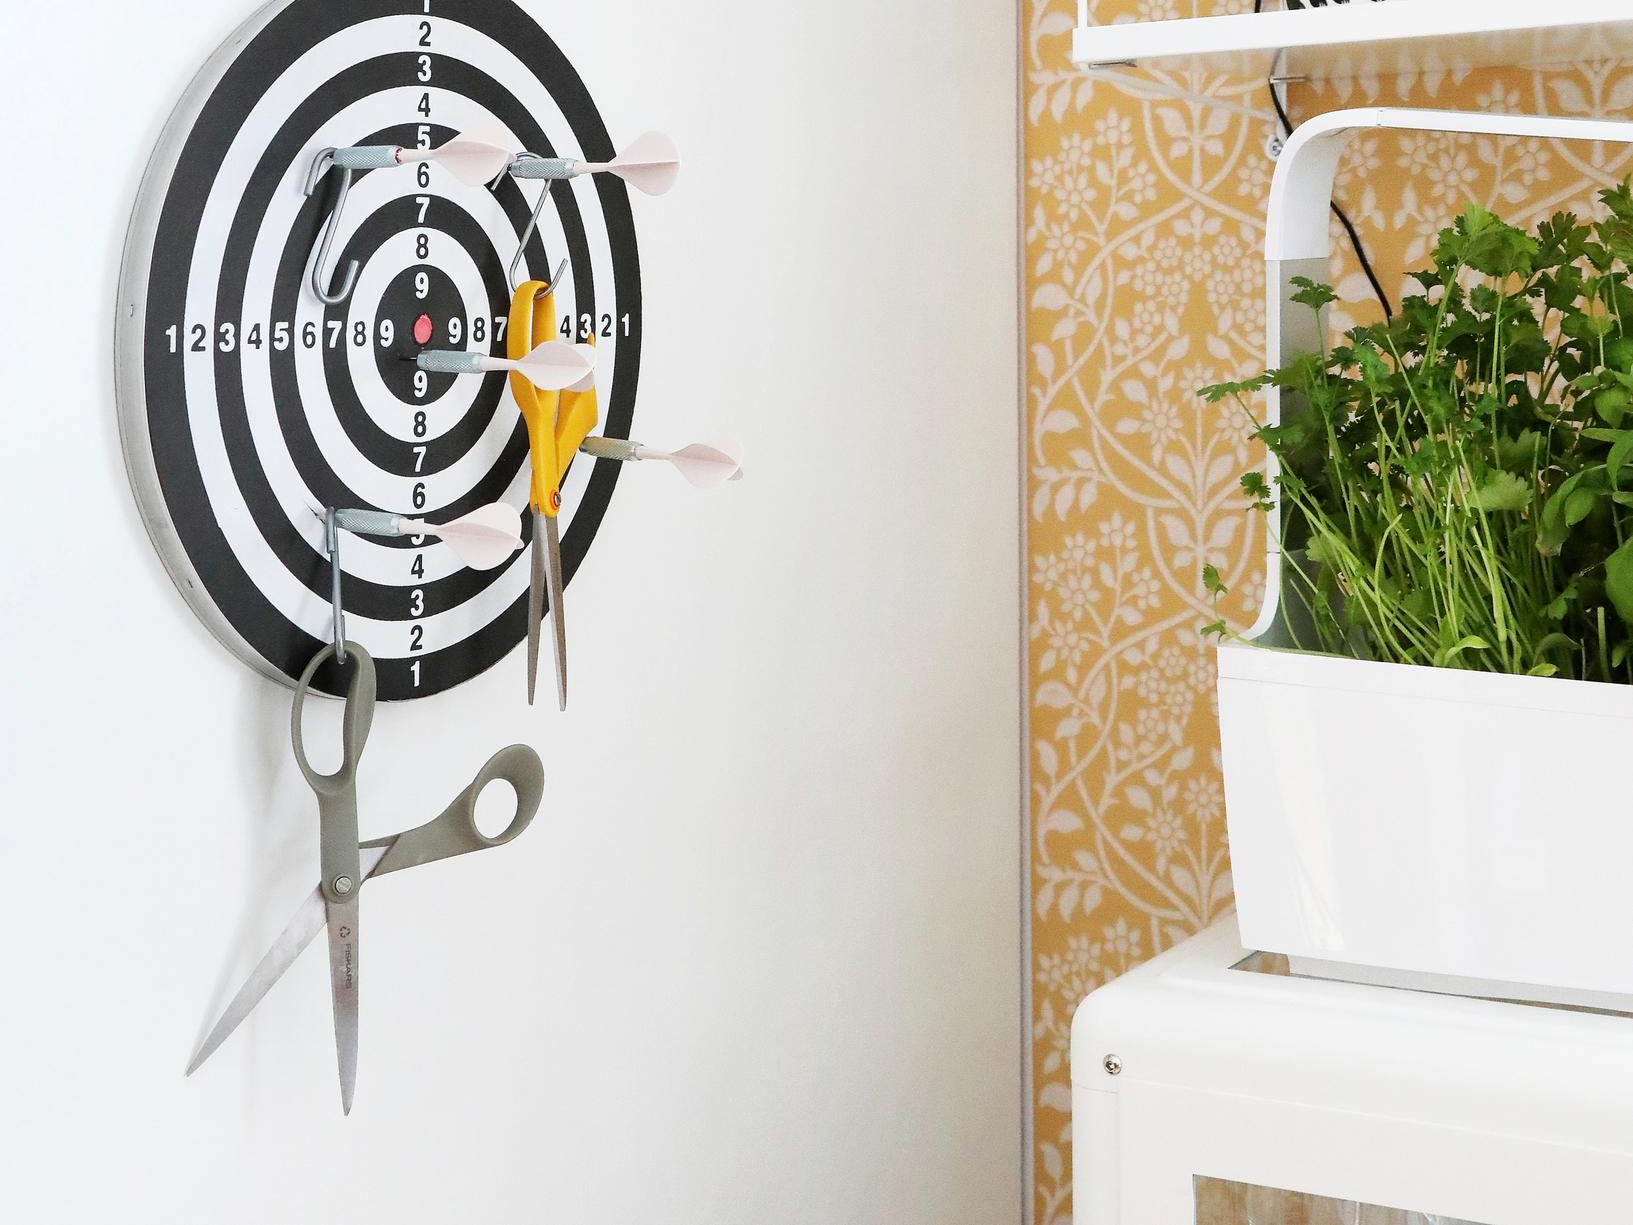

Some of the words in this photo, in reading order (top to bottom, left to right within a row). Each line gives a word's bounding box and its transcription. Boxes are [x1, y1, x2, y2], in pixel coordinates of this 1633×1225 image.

[419, 21, 431, 46] 2
[417, 55, 431, 81] 3
[418, 93, 430, 117] 4
[417, 126, 430, 150] 5
[417, 162, 429, 188] 6
[416, 197, 430, 223] 7
[416, 233, 428, 259] 8
[415, 272, 429, 299] 9
[166, 325, 176, 352] 1
[191, 324, 206, 352] 2
[219, 323, 235, 352] 3
[248, 323, 262, 349] 4
[273, 322, 289, 350] 5
[302, 322, 316, 348] 6
[327, 321, 342, 348] 7
[353, 321, 366, 346] 8
[380, 319, 394, 347] 9
[448, 317, 461, 344] 9
[473, 317, 485, 342] 8
[495, 317, 507, 341] 7
[560, 315, 571, 338] 4
[580, 313, 591, 338] 3
[601, 313, 612, 337] 2
[622, 313, 630, 336] 1
[414, 370, 427, 397] 9
[414, 411, 426, 437] 8
[413, 446, 426, 472] 7
[413, 482, 425, 509] 6
[411, 554, 424, 579] 4
[411, 589, 424, 616] 3
[410, 625, 423, 651] 2
[411, 661, 420, 687] 1
